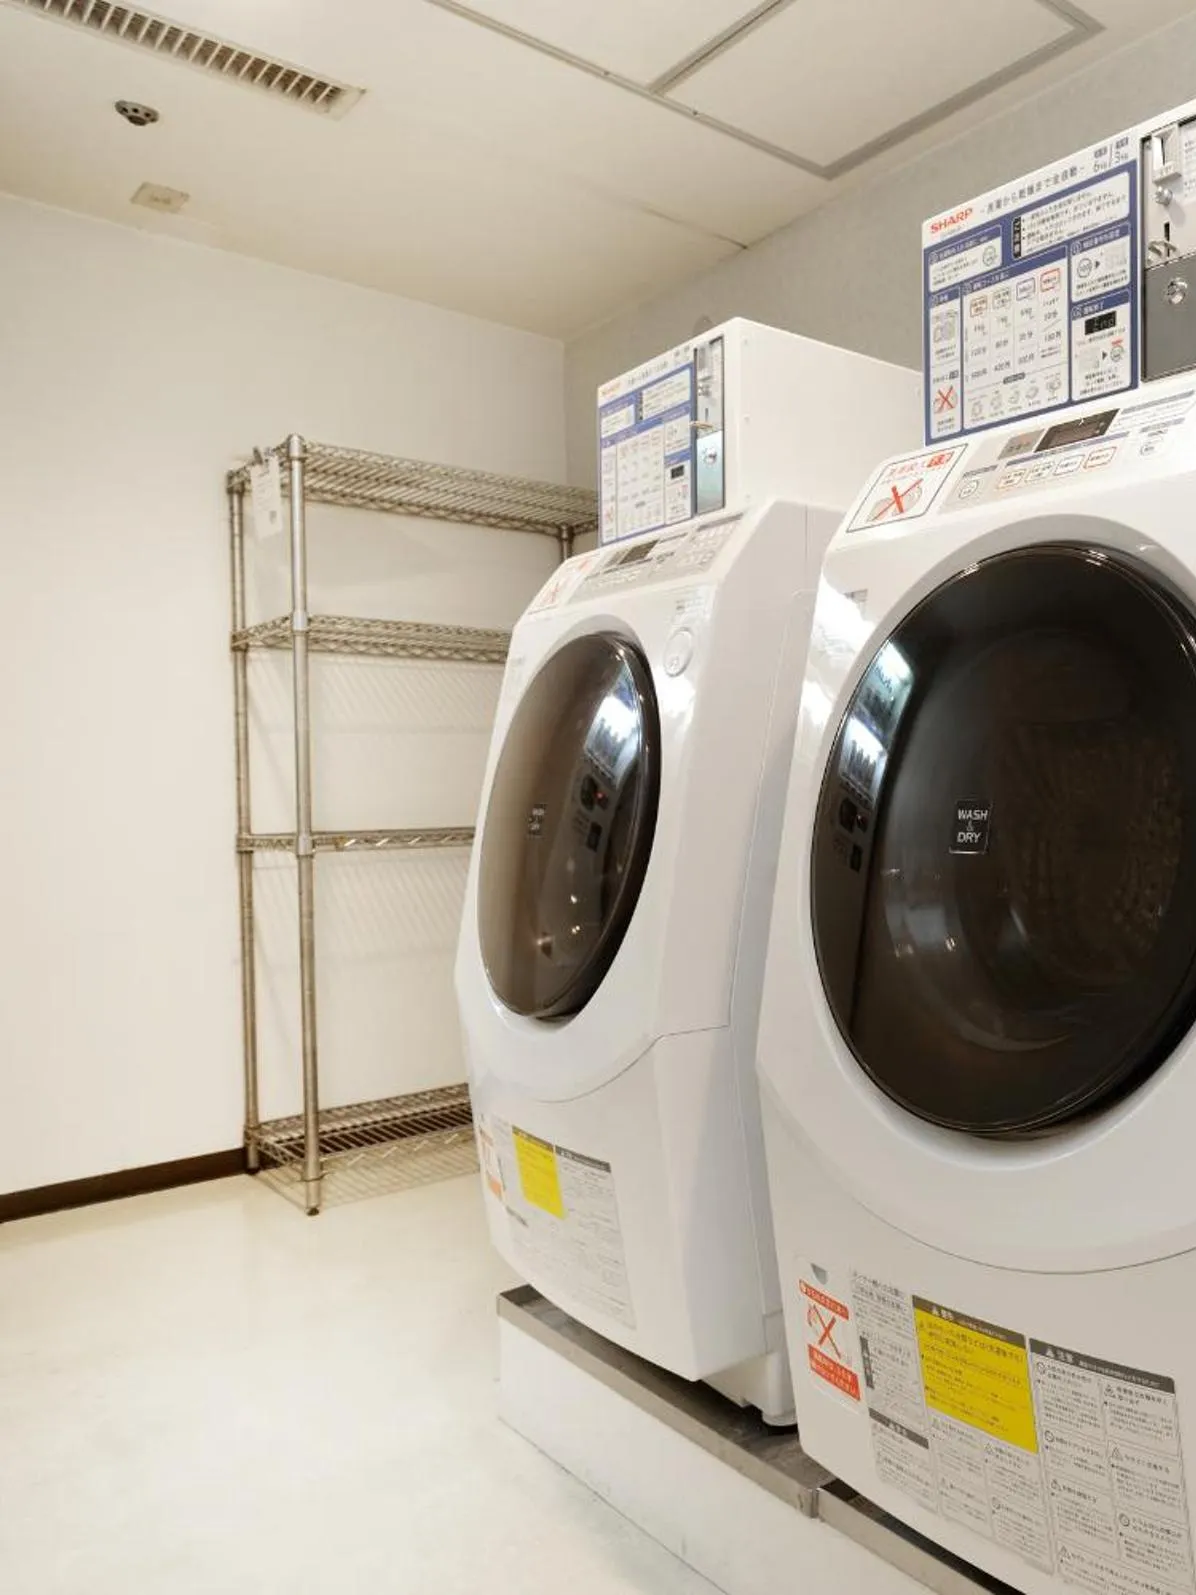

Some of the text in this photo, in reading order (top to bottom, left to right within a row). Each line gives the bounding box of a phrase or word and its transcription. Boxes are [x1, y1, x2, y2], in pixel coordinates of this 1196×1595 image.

[929, 209, 973, 233] SHARP
[957, 808, 988, 821] WASH
[957, 831, 982, 843] DRY
